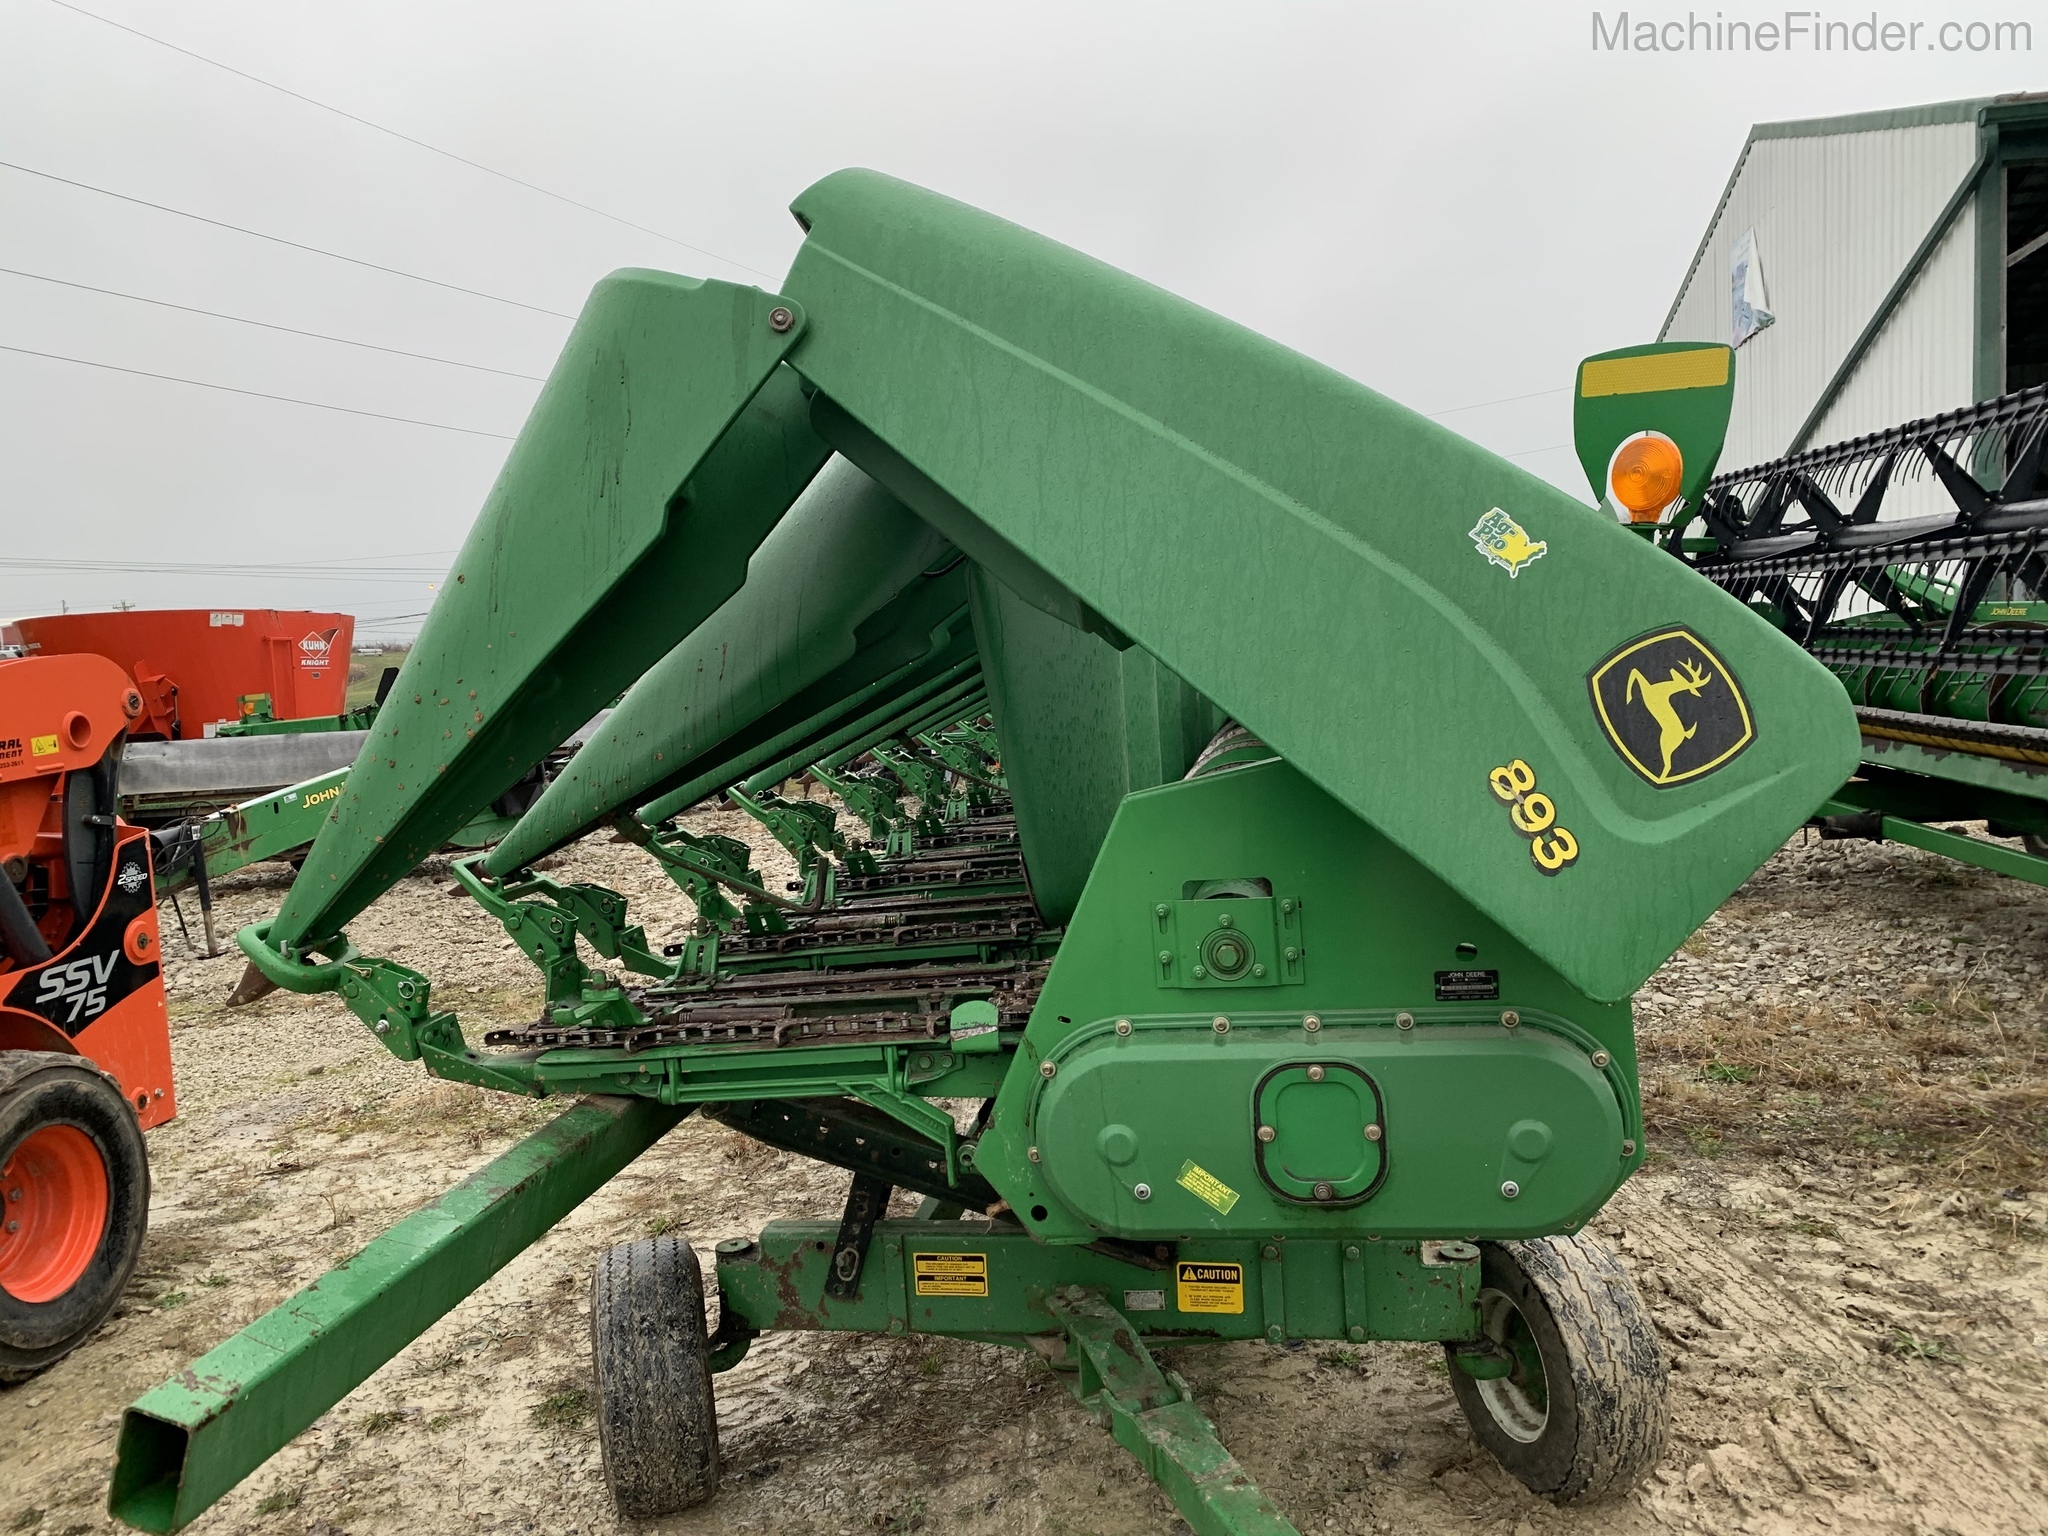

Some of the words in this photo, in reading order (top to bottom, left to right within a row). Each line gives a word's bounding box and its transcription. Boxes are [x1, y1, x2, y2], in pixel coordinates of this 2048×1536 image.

[1473, 522, 1507, 551] Pro
[302, 640, 326, 650] KUHN
[302, 785, 340, 809] JOHN
[1489, 758, 1580, 873] 893
[35, 949, 120, 1004] SSV
[65, 985, 107, 1023] 75
[1192, 1166, 1233, 1196] IMPORTANT
[1197, 1268, 1238, 1280] CAUTION
